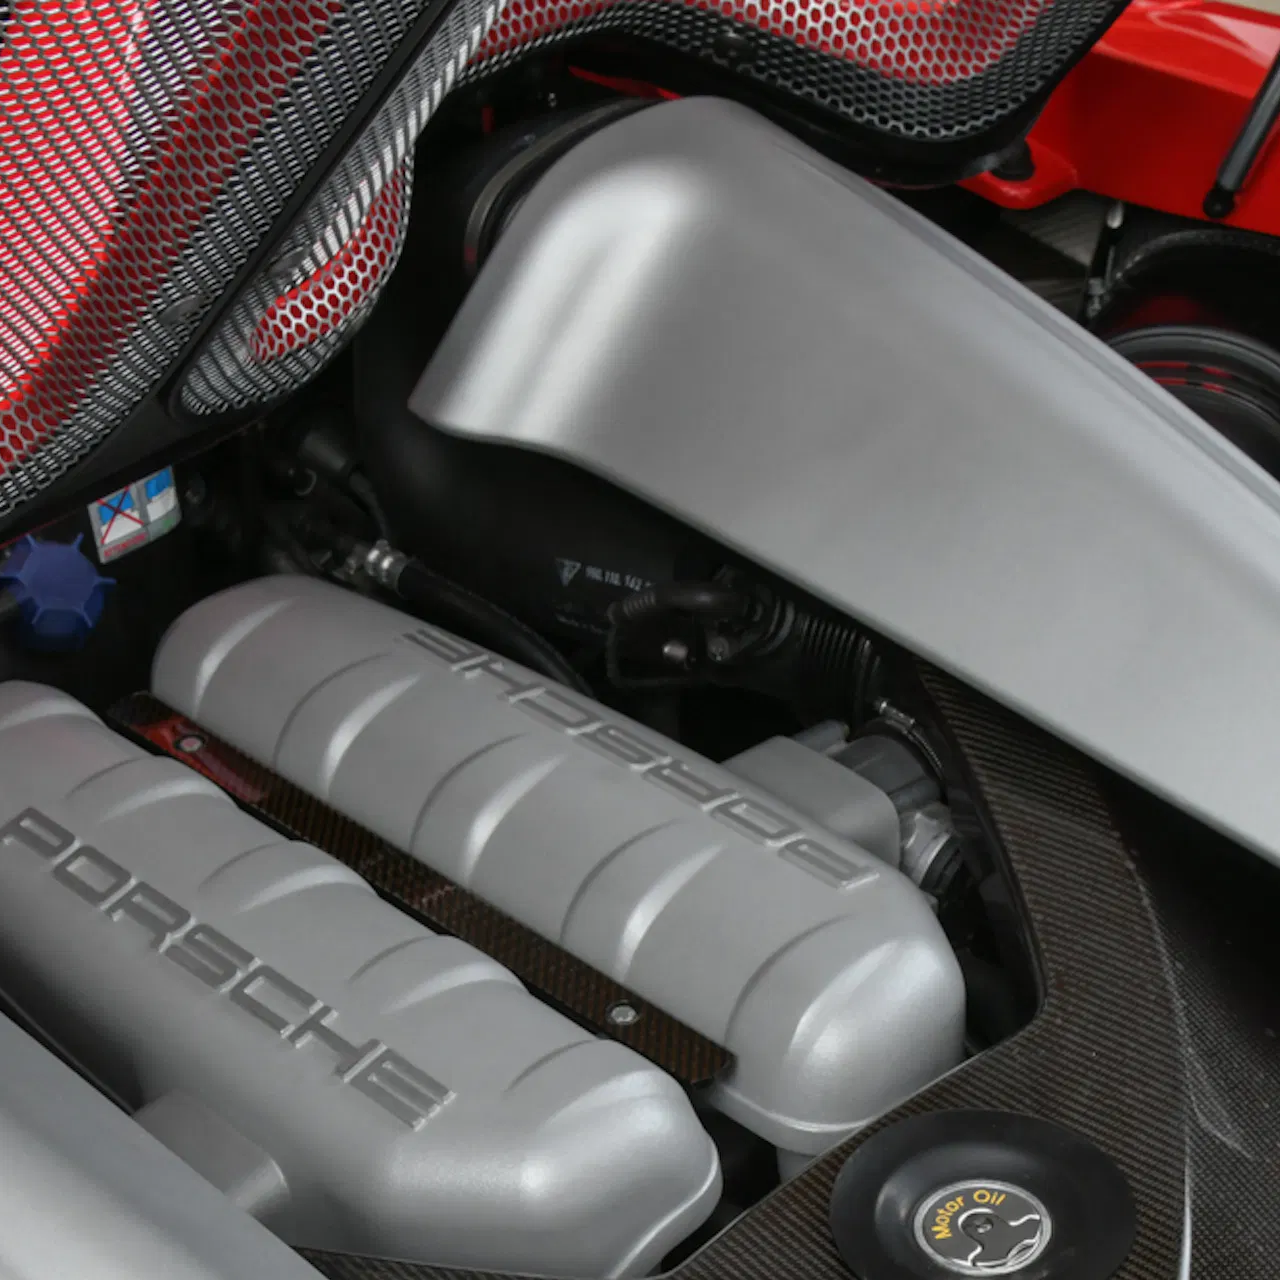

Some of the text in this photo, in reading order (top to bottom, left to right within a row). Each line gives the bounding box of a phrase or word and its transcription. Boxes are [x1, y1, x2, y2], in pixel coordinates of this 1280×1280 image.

[401, 628, 880, 891] PORSCHE
[931, 1189, 1007, 1240] Motor Oil
